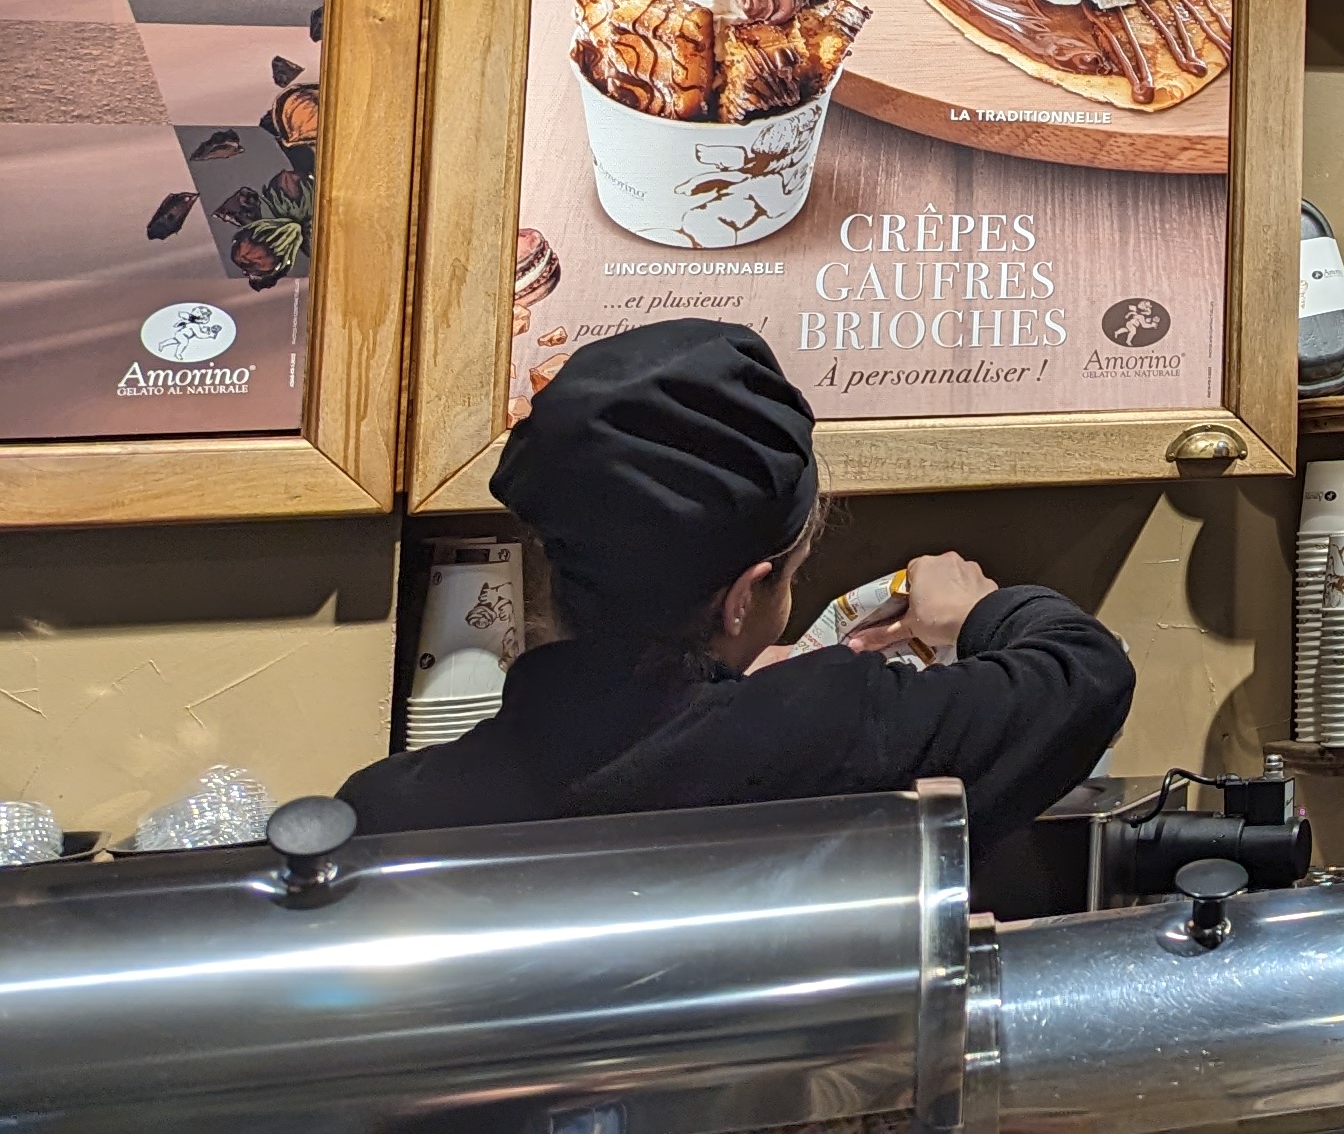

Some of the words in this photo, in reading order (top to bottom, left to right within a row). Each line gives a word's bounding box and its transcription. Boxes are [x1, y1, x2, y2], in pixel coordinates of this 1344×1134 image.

[950, 108, 971, 122] LA
[976, 109, 1112, 125] TRADITIONNELLE
[840, 202, 1037, 253] CRÊPES
[604, 262, 785, 276] L'INCONTOURNABLE
[815, 260, 1055, 302] GAUFRES
[645, 291, 744, 313] plusieurs
[797, 307, 1069, 351] BRIOCHES
[1083, 349, 1181, 371] Amorino
[118, 362, 250, 388] Amorino
[814, 357, 838, 388] À
[841, 361, 1031, 394] personnaliser
[1082, 370, 1117, 380] GELATO
[1119, 369, 1132, 379] AL
[1134, 369, 1181, 378] NATURALE
[117, 386, 164, 397] GELATO
[168, 385, 183, 395] AL
[187, 385, 248, 395] NATURALE
